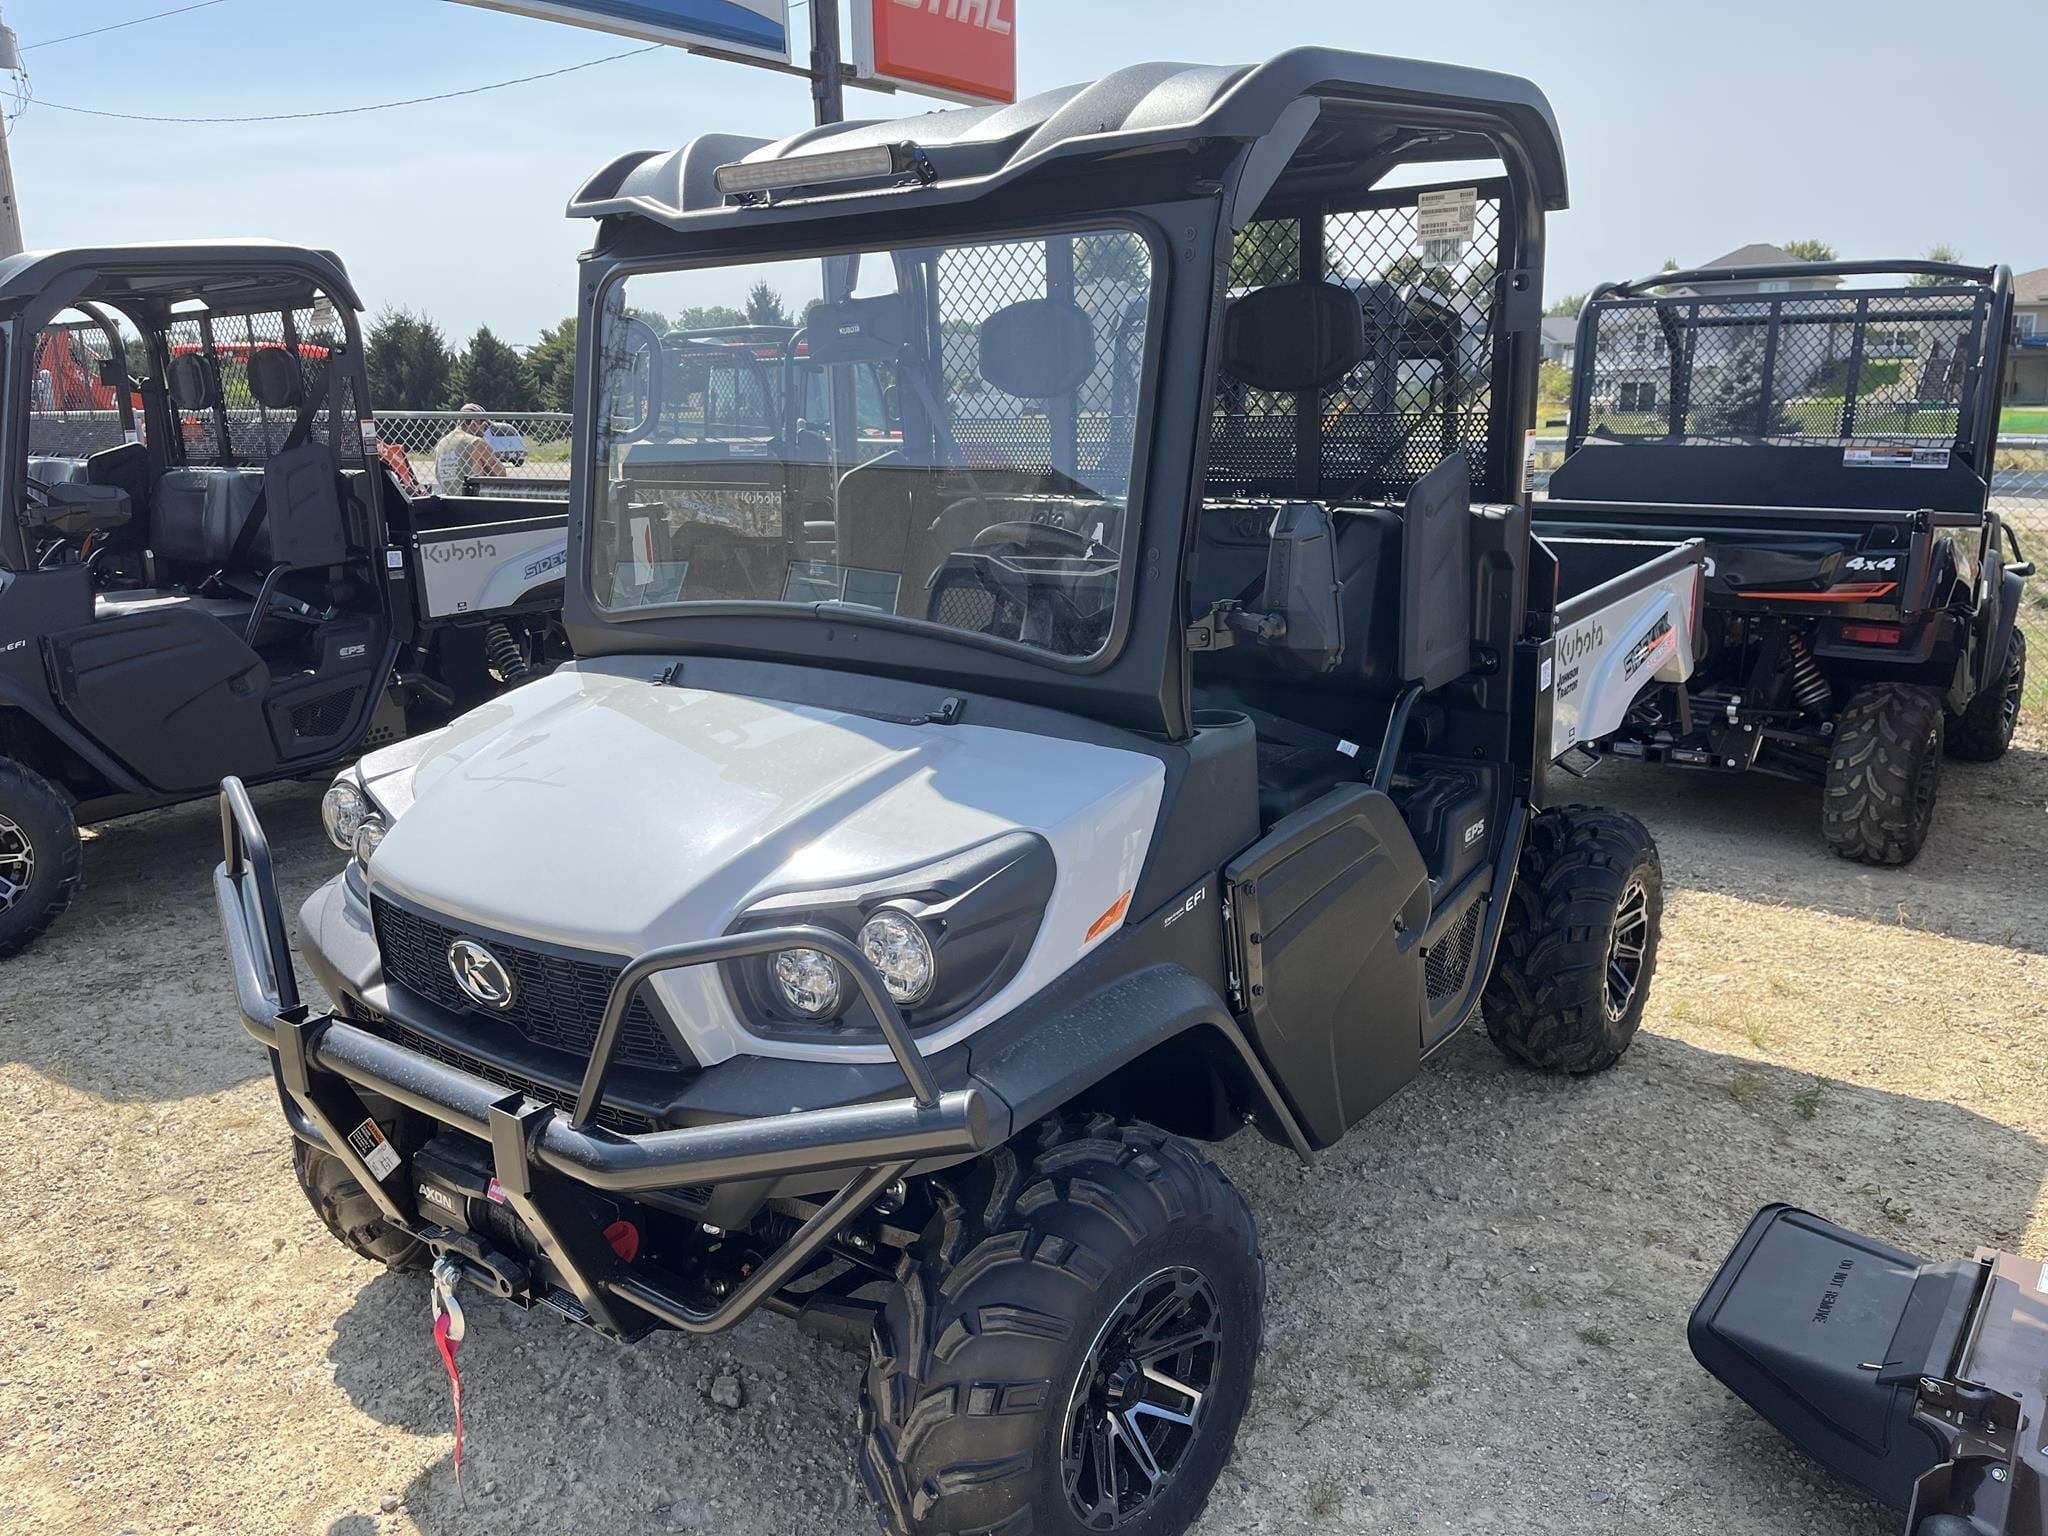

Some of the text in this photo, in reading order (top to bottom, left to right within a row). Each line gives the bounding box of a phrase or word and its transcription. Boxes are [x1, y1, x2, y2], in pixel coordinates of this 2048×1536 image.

[424, 541, 496, 563] Kubota
[1846, 557, 1896, 571] 4x4
[7, 640, 26, 650] EFI
[340, 645, 365, 656] EPS
[1558, 620, 1603, 666] Kubota
[1556, 667, 1579, 687] JOHNSON
[1557, 680, 1579, 700] TRACTOR
[1465, 818, 1485, 842] EPS
[1185, 887, 1205, 912] EFI
[418, 1183, 453, 1209] AXON
[1811, 1259, 1855, 1324] DO NOT REMOVE
